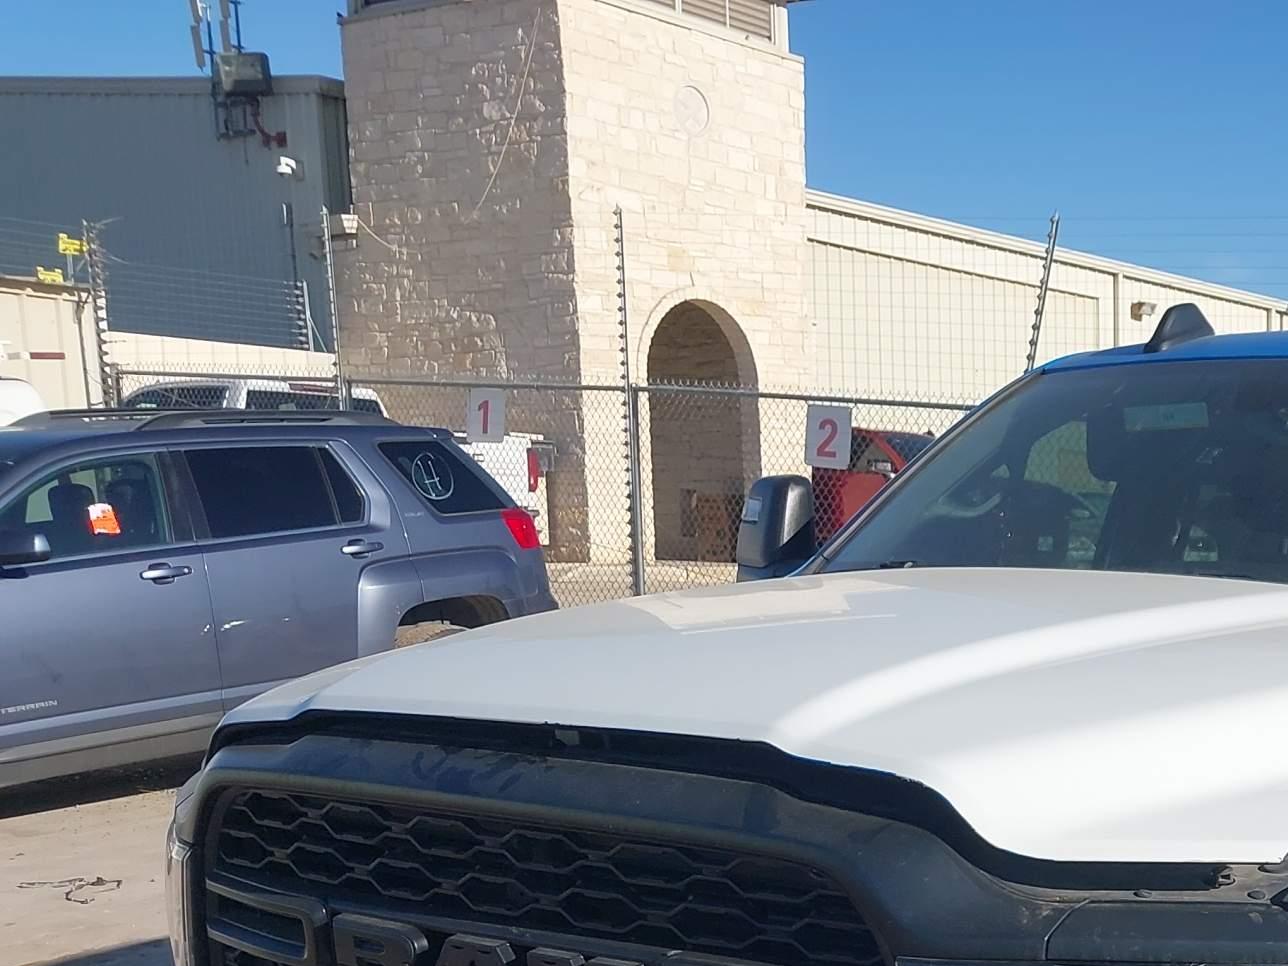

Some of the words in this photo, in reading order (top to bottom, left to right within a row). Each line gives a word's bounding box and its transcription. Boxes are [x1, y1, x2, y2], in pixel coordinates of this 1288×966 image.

[477, 399, 490, 435] 1
[815, 418, 839, 459] 2
[0, 699, 58, 715] TERRAIN
